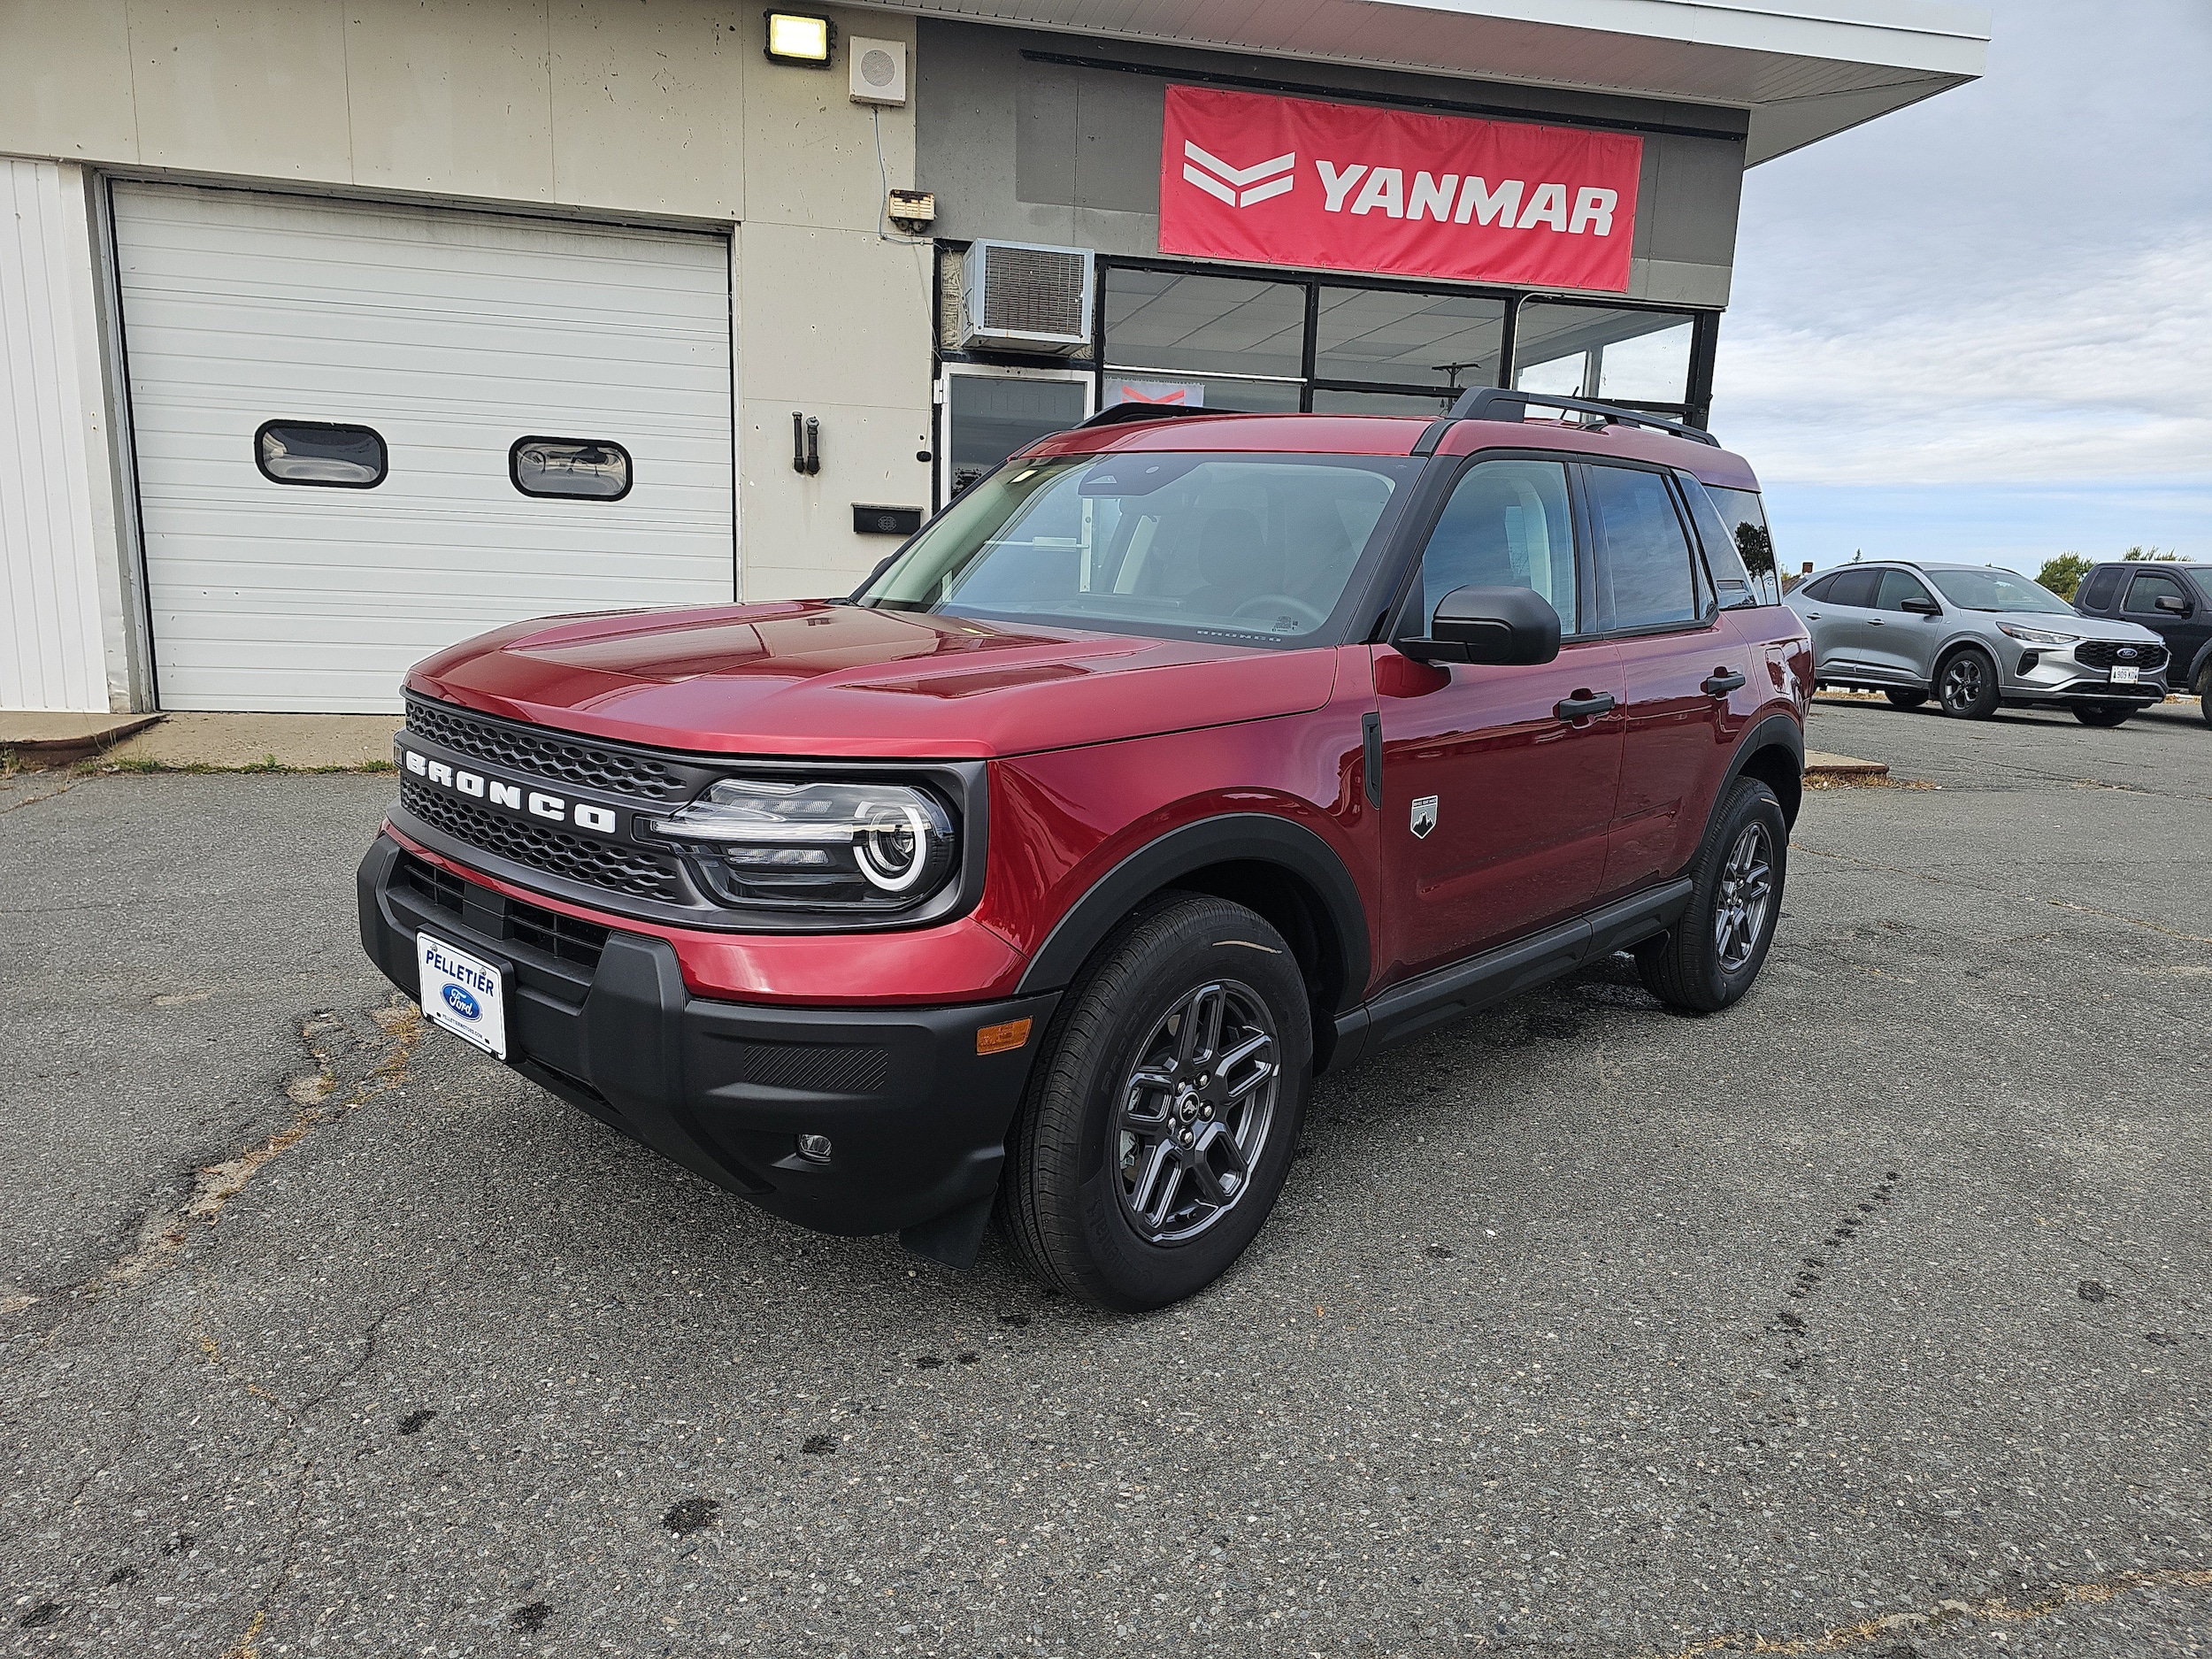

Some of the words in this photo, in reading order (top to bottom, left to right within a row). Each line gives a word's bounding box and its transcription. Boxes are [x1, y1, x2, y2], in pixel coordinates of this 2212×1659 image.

[1315, 160, 1618, 236] YANMAR
[406, 750, 616, 833] BRONCO
[426, 949, 494, 997] PELLETIER
[449, 988, 473, 1016] Ford
